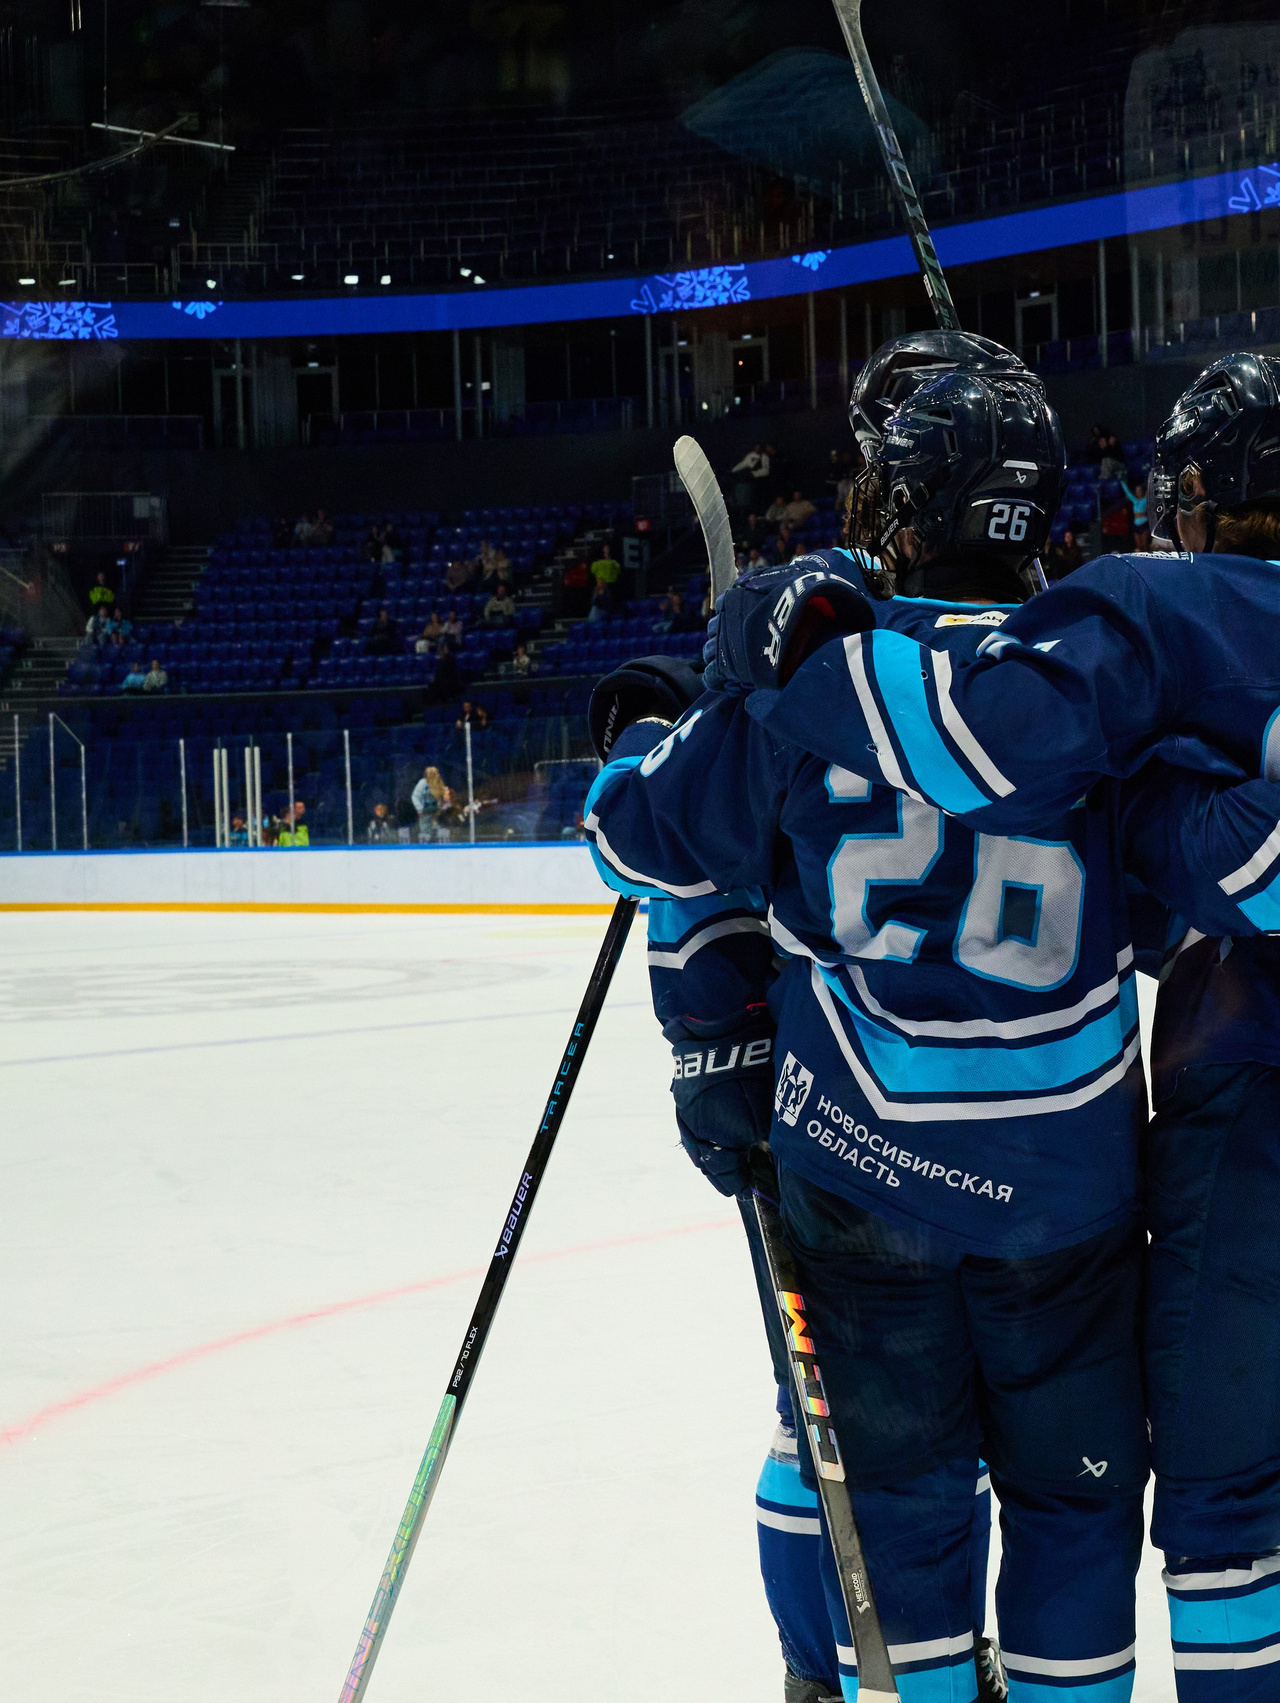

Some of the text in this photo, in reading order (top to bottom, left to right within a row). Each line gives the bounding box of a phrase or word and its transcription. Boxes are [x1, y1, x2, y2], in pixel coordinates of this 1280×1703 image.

[877, 123, 954, 307] SOYUZ
[988, 503, 1030, 541] 26
[826, 763, 1086, 992] 26
[540, 1021, 584, 1133] TRACER
[674, 1038, 771, 1080] BAUE
[806, 1119, 901, 1188] ОБЛАСТЬ
[816, 1095, 1014, 1203] НОВОСИБИРСКАЯ
[502, 1171, 533, 1245] BAUER
[465, 1326, 479, 1349] FLEX
[778, 1290, 847, 1483] CCM
[851, 1572, 862, 1602] HELICOID
